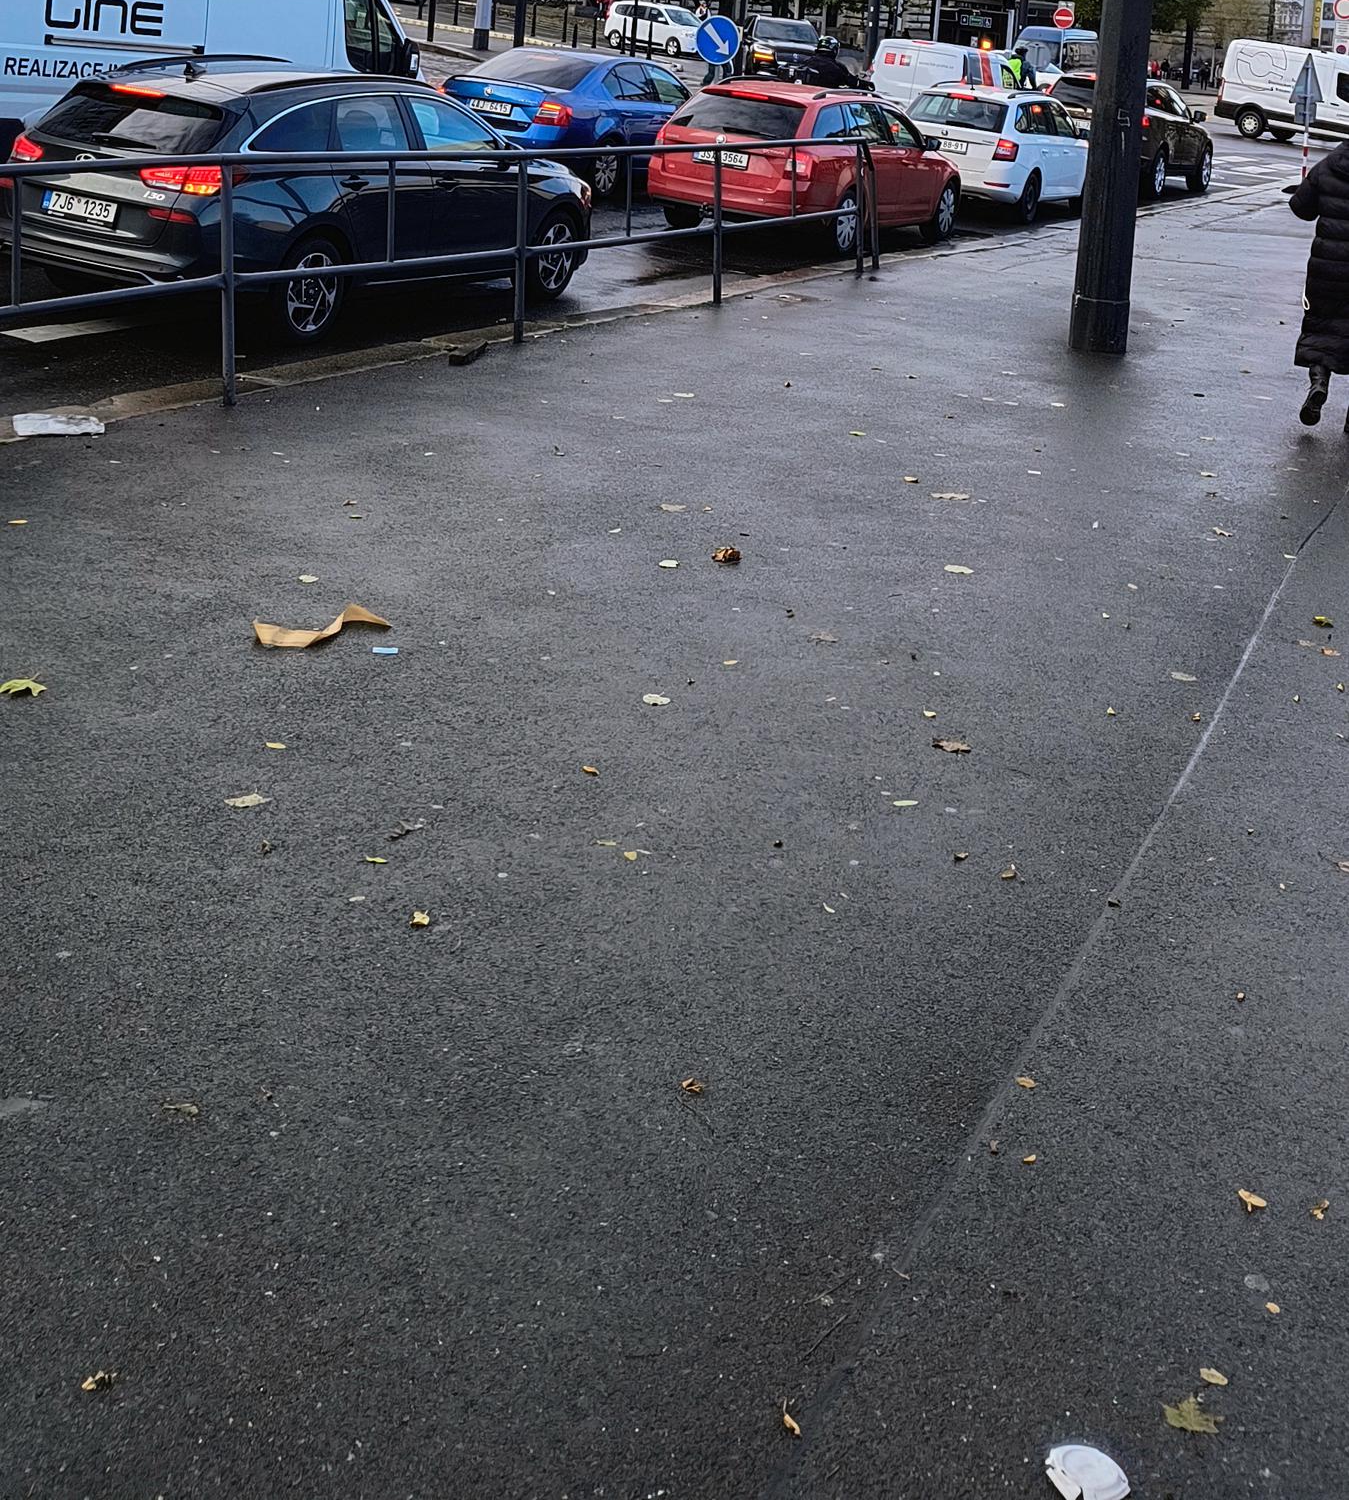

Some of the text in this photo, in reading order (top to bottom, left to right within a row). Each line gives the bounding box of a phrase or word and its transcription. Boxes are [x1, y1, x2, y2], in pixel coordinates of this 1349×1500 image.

[4, 57, 103, 79] REALIZACE
[723, 153, 743, 164] 3564
[52, 194, 112, 218] 7J6 1235
